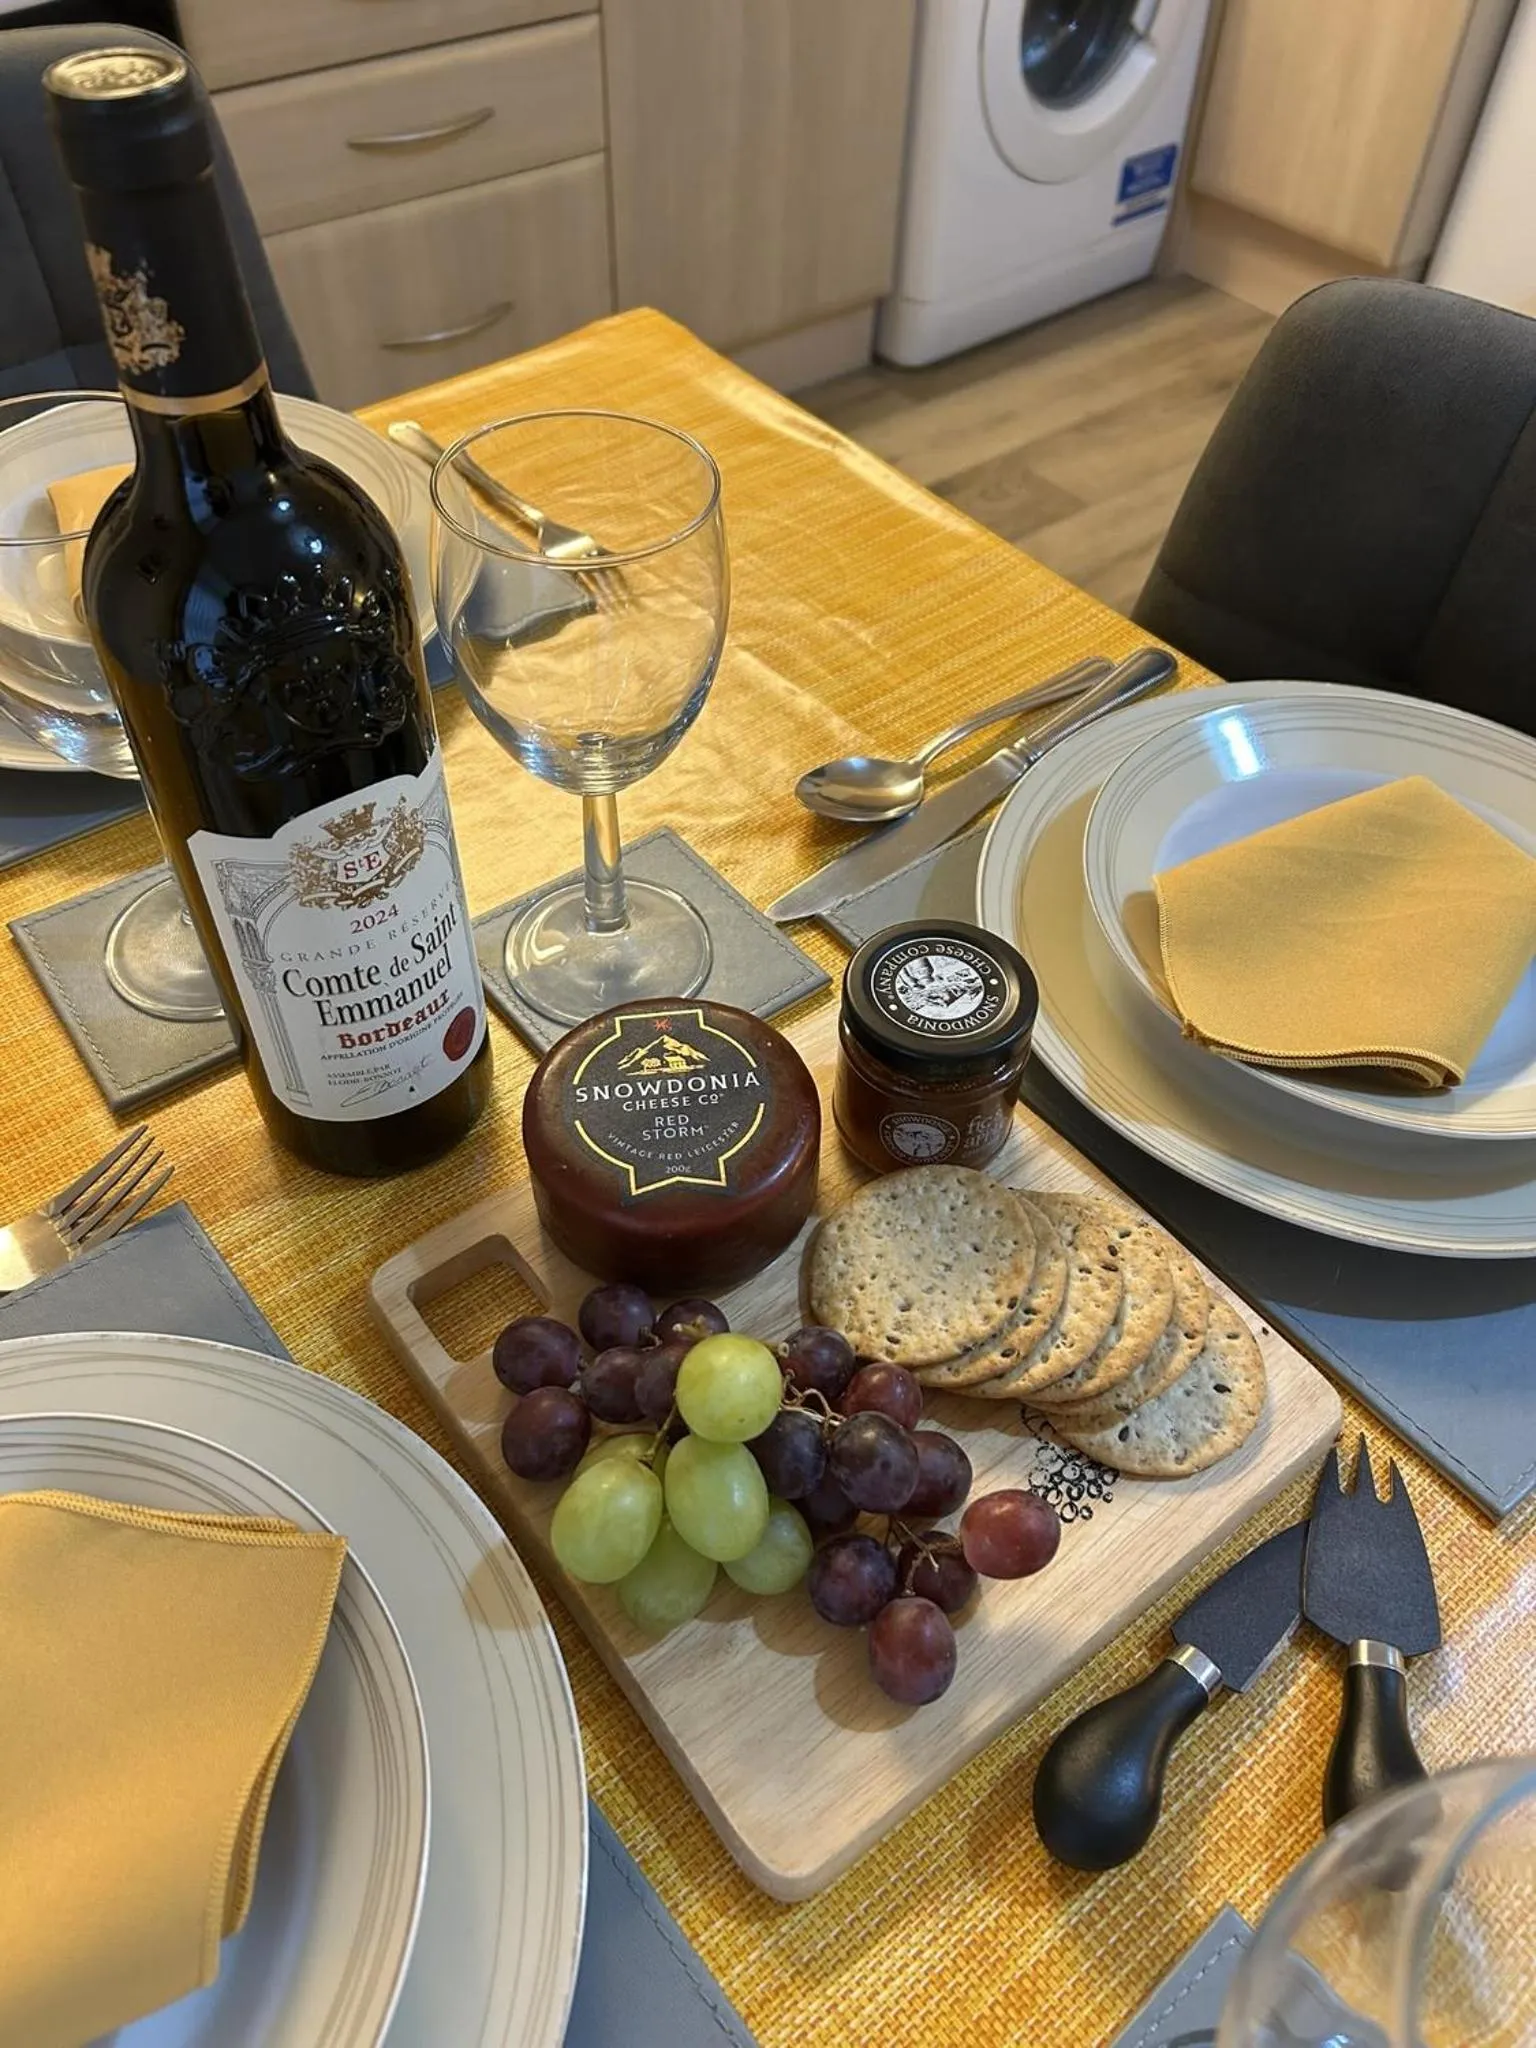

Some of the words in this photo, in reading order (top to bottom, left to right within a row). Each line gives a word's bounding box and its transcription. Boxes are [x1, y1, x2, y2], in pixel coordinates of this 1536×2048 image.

[351, 903, 400, 935] 2024
[281, 938, 377, 963] GRANDE
[282, 968, 382, 998] Comte
[389, 955, 410, 979] de
[411, 900, 457, 964] Saint
[313, 942, 452, 1027] Emmanuel
[337, 989, 450, 1050] Bordeaux
[575, 1071, 761, 1103] SNOWDONIA
[622, 1096, 692, 1112] CHEESE
[654, 1114, 690, 1128] RED
[608, 1132, 653, 1159] VINTAGE
[659, 1152, 683, 1160] RED
[687, 1121, 740, 1159] LEICESTER
